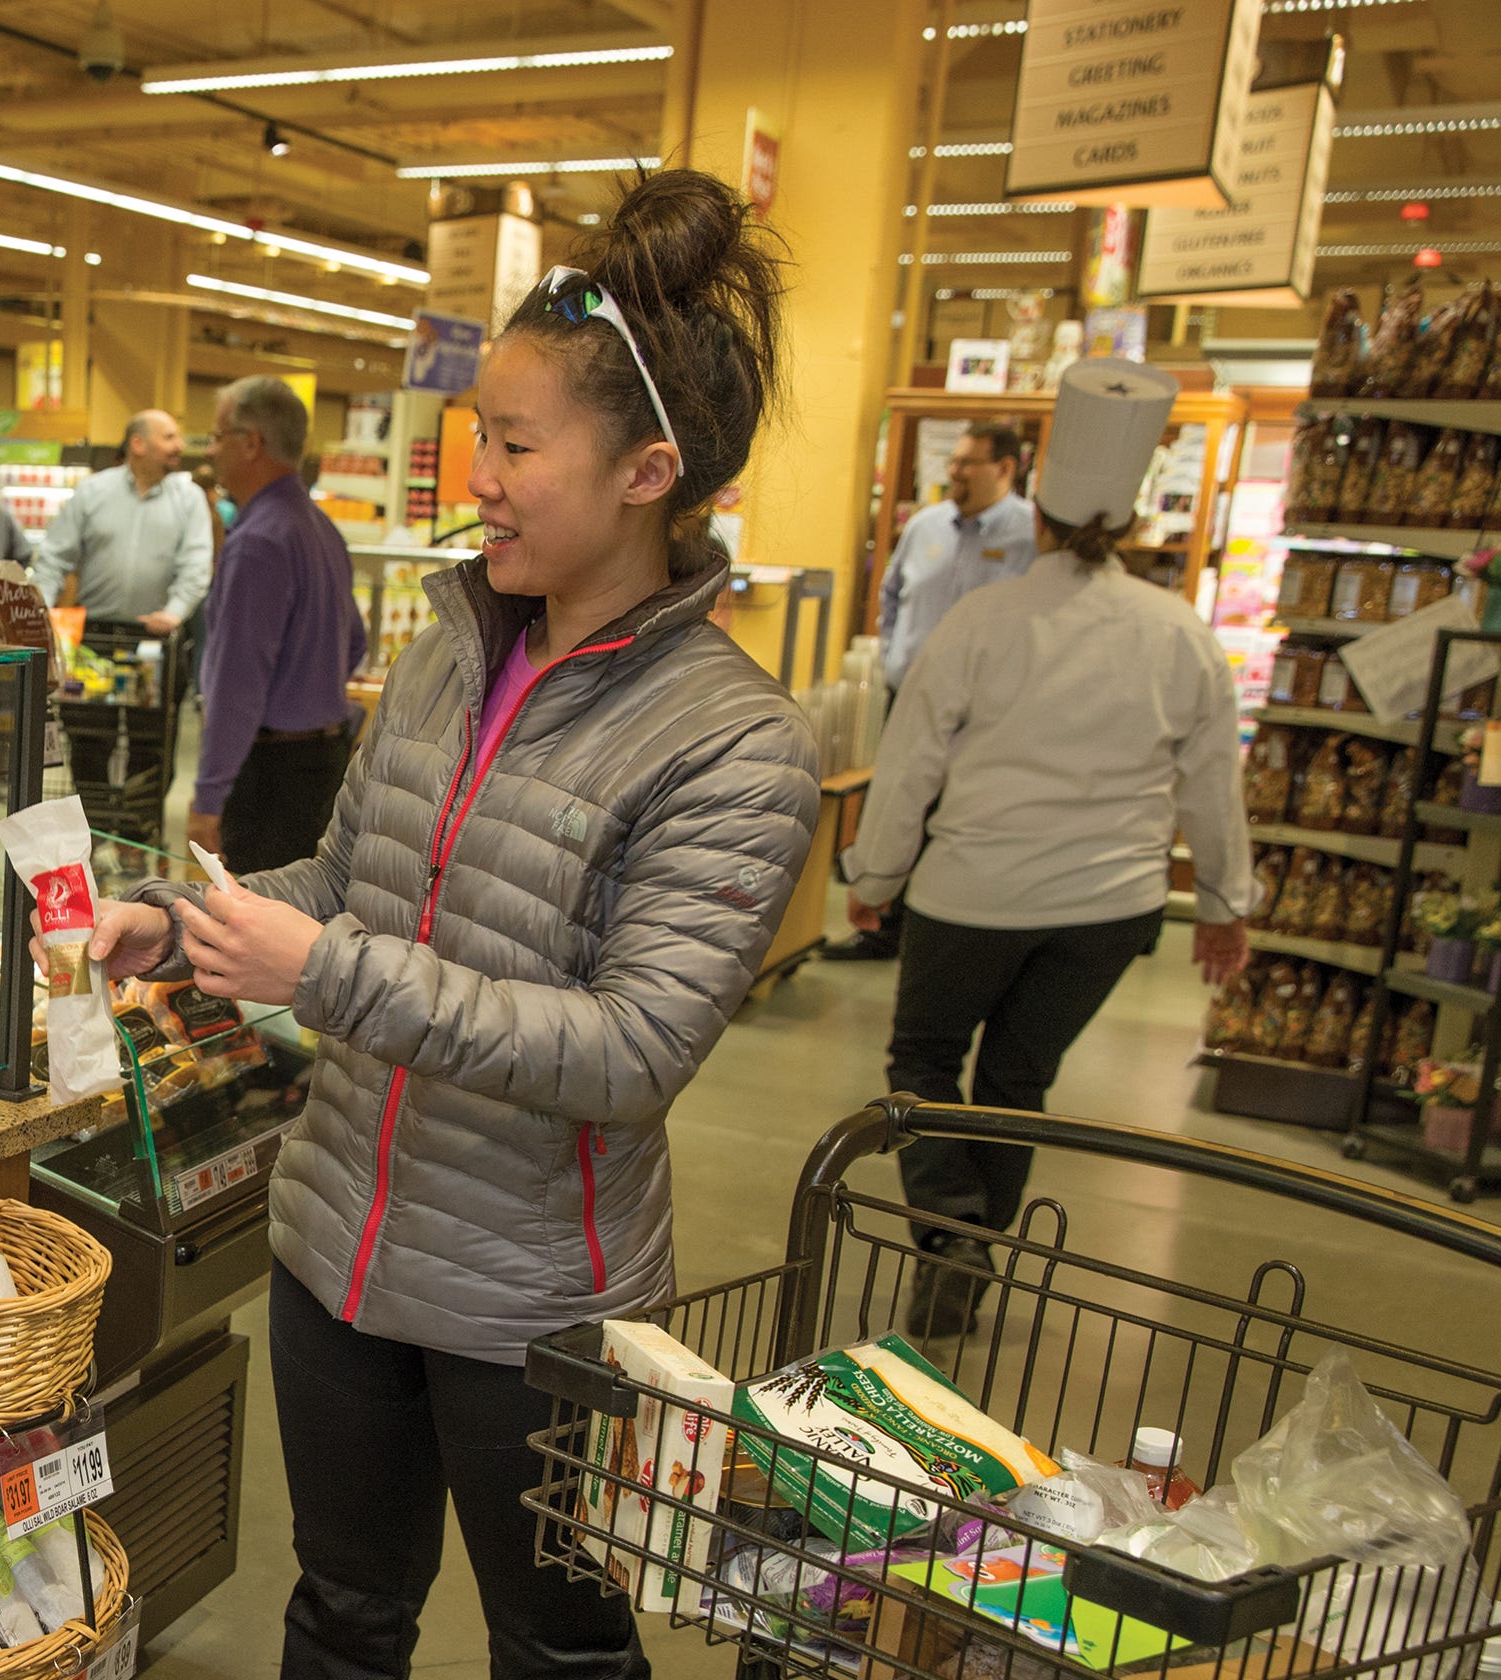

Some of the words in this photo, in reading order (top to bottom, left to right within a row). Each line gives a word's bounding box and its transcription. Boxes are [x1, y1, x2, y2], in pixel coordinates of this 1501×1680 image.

[1064, 8, 1185, 47] STATIONERY
[1068, 52, 1165, 87] GREETING
[1055, 94, 1171, 128] MAGAZINES
[1073, 139, 1140, 168] CARDS
[44, 909, 70, 923] OLLI
[850, 1382, 882, 1415] SHREDDED
[881, 1412, 908, 1434] FANCY
[886, 1404, 983, 1463] MOZZARELLA
[816, 1427, 870, 1467] VALLEY
[914, 1433, 958, 1459] ORGANIC
[72, 1447, 103, 1487] $11.99
[6, 1478, 31, 1511] $31.97
[33, 1515, 43, 1528] SAL
[43, 1508, 54, 1523] WILD
[54, 1503, 68, 1519] BOAR
[90, 1488, 99, 1499] OZ
[1034, 1490, 1048, 1499] NET
[672, 1510, 686, 1549] aramel
